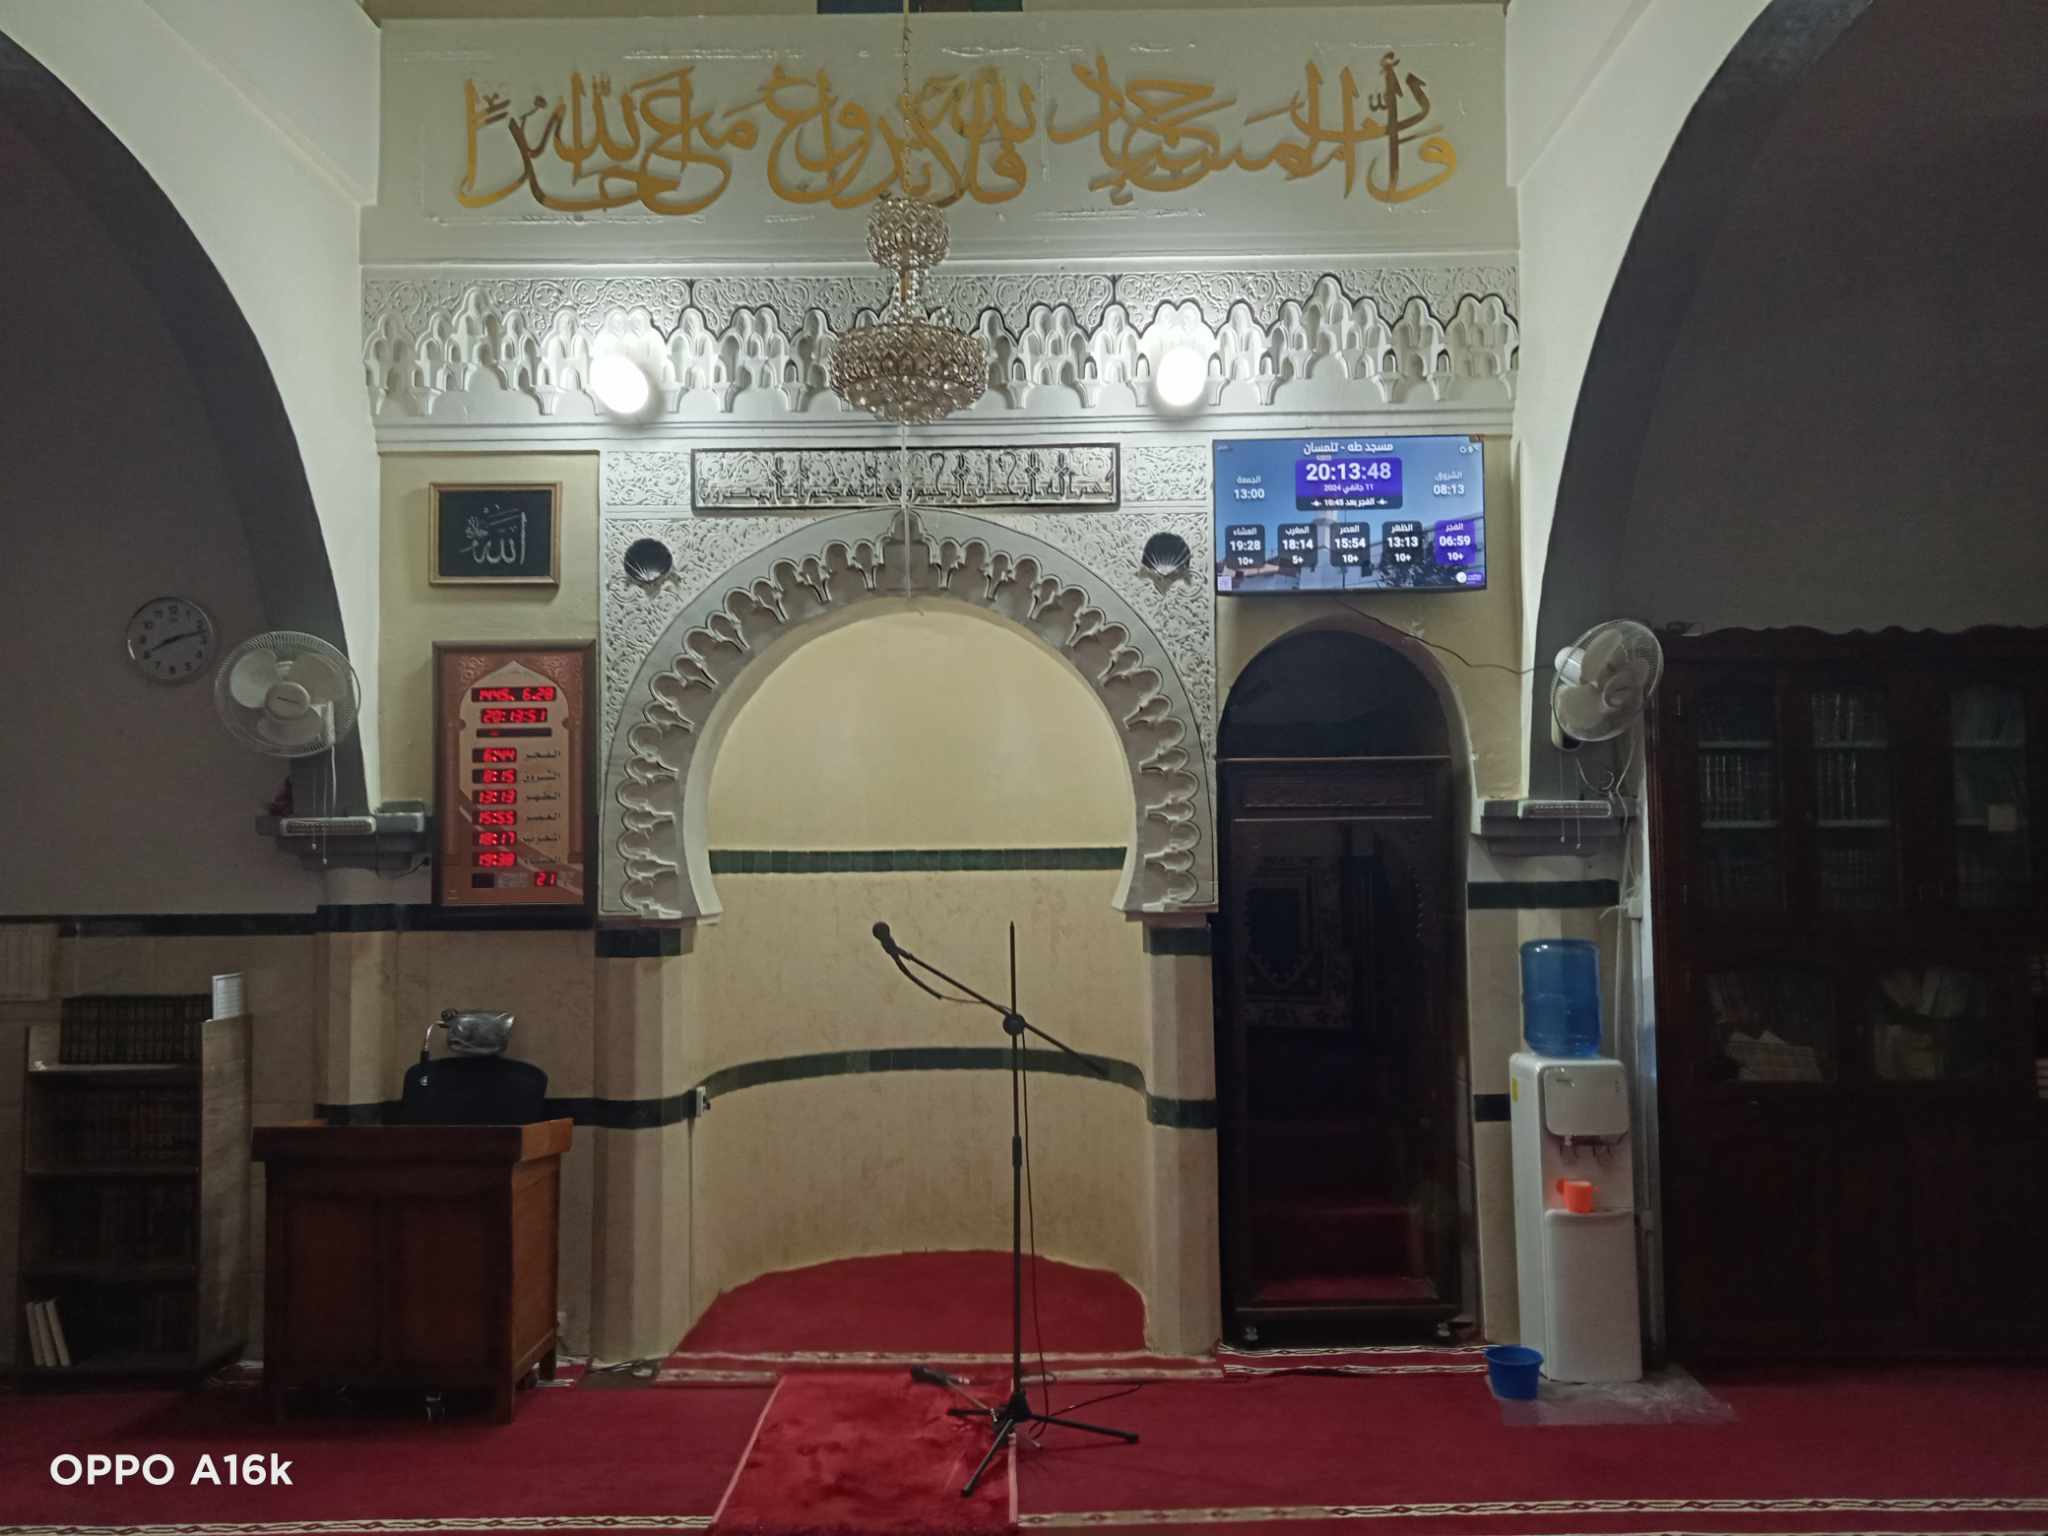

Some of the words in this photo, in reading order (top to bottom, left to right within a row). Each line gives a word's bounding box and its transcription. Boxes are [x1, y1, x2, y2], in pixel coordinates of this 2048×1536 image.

[1303, 442, 1338, 455] تلمسان
[1347, 441, 1363, 451] طه
[1364, 443, 1393, 453] مسجد
[1306, 462, 1391, 480] 20:13:48
[1233, 488, 1265, 500] 13:00
[1433, 484, 1465, 495] 08:13
[459, 511, 528, 566] الله
[1282, 539, 1314, 550] 18:14
[1334, 537, 1367, 549] 15:54
[1386, 536, 1419, 548] 13:13
[1438, 535, 1472, 547] 06:59
[1230, 540, 1261, 551] 19:28
